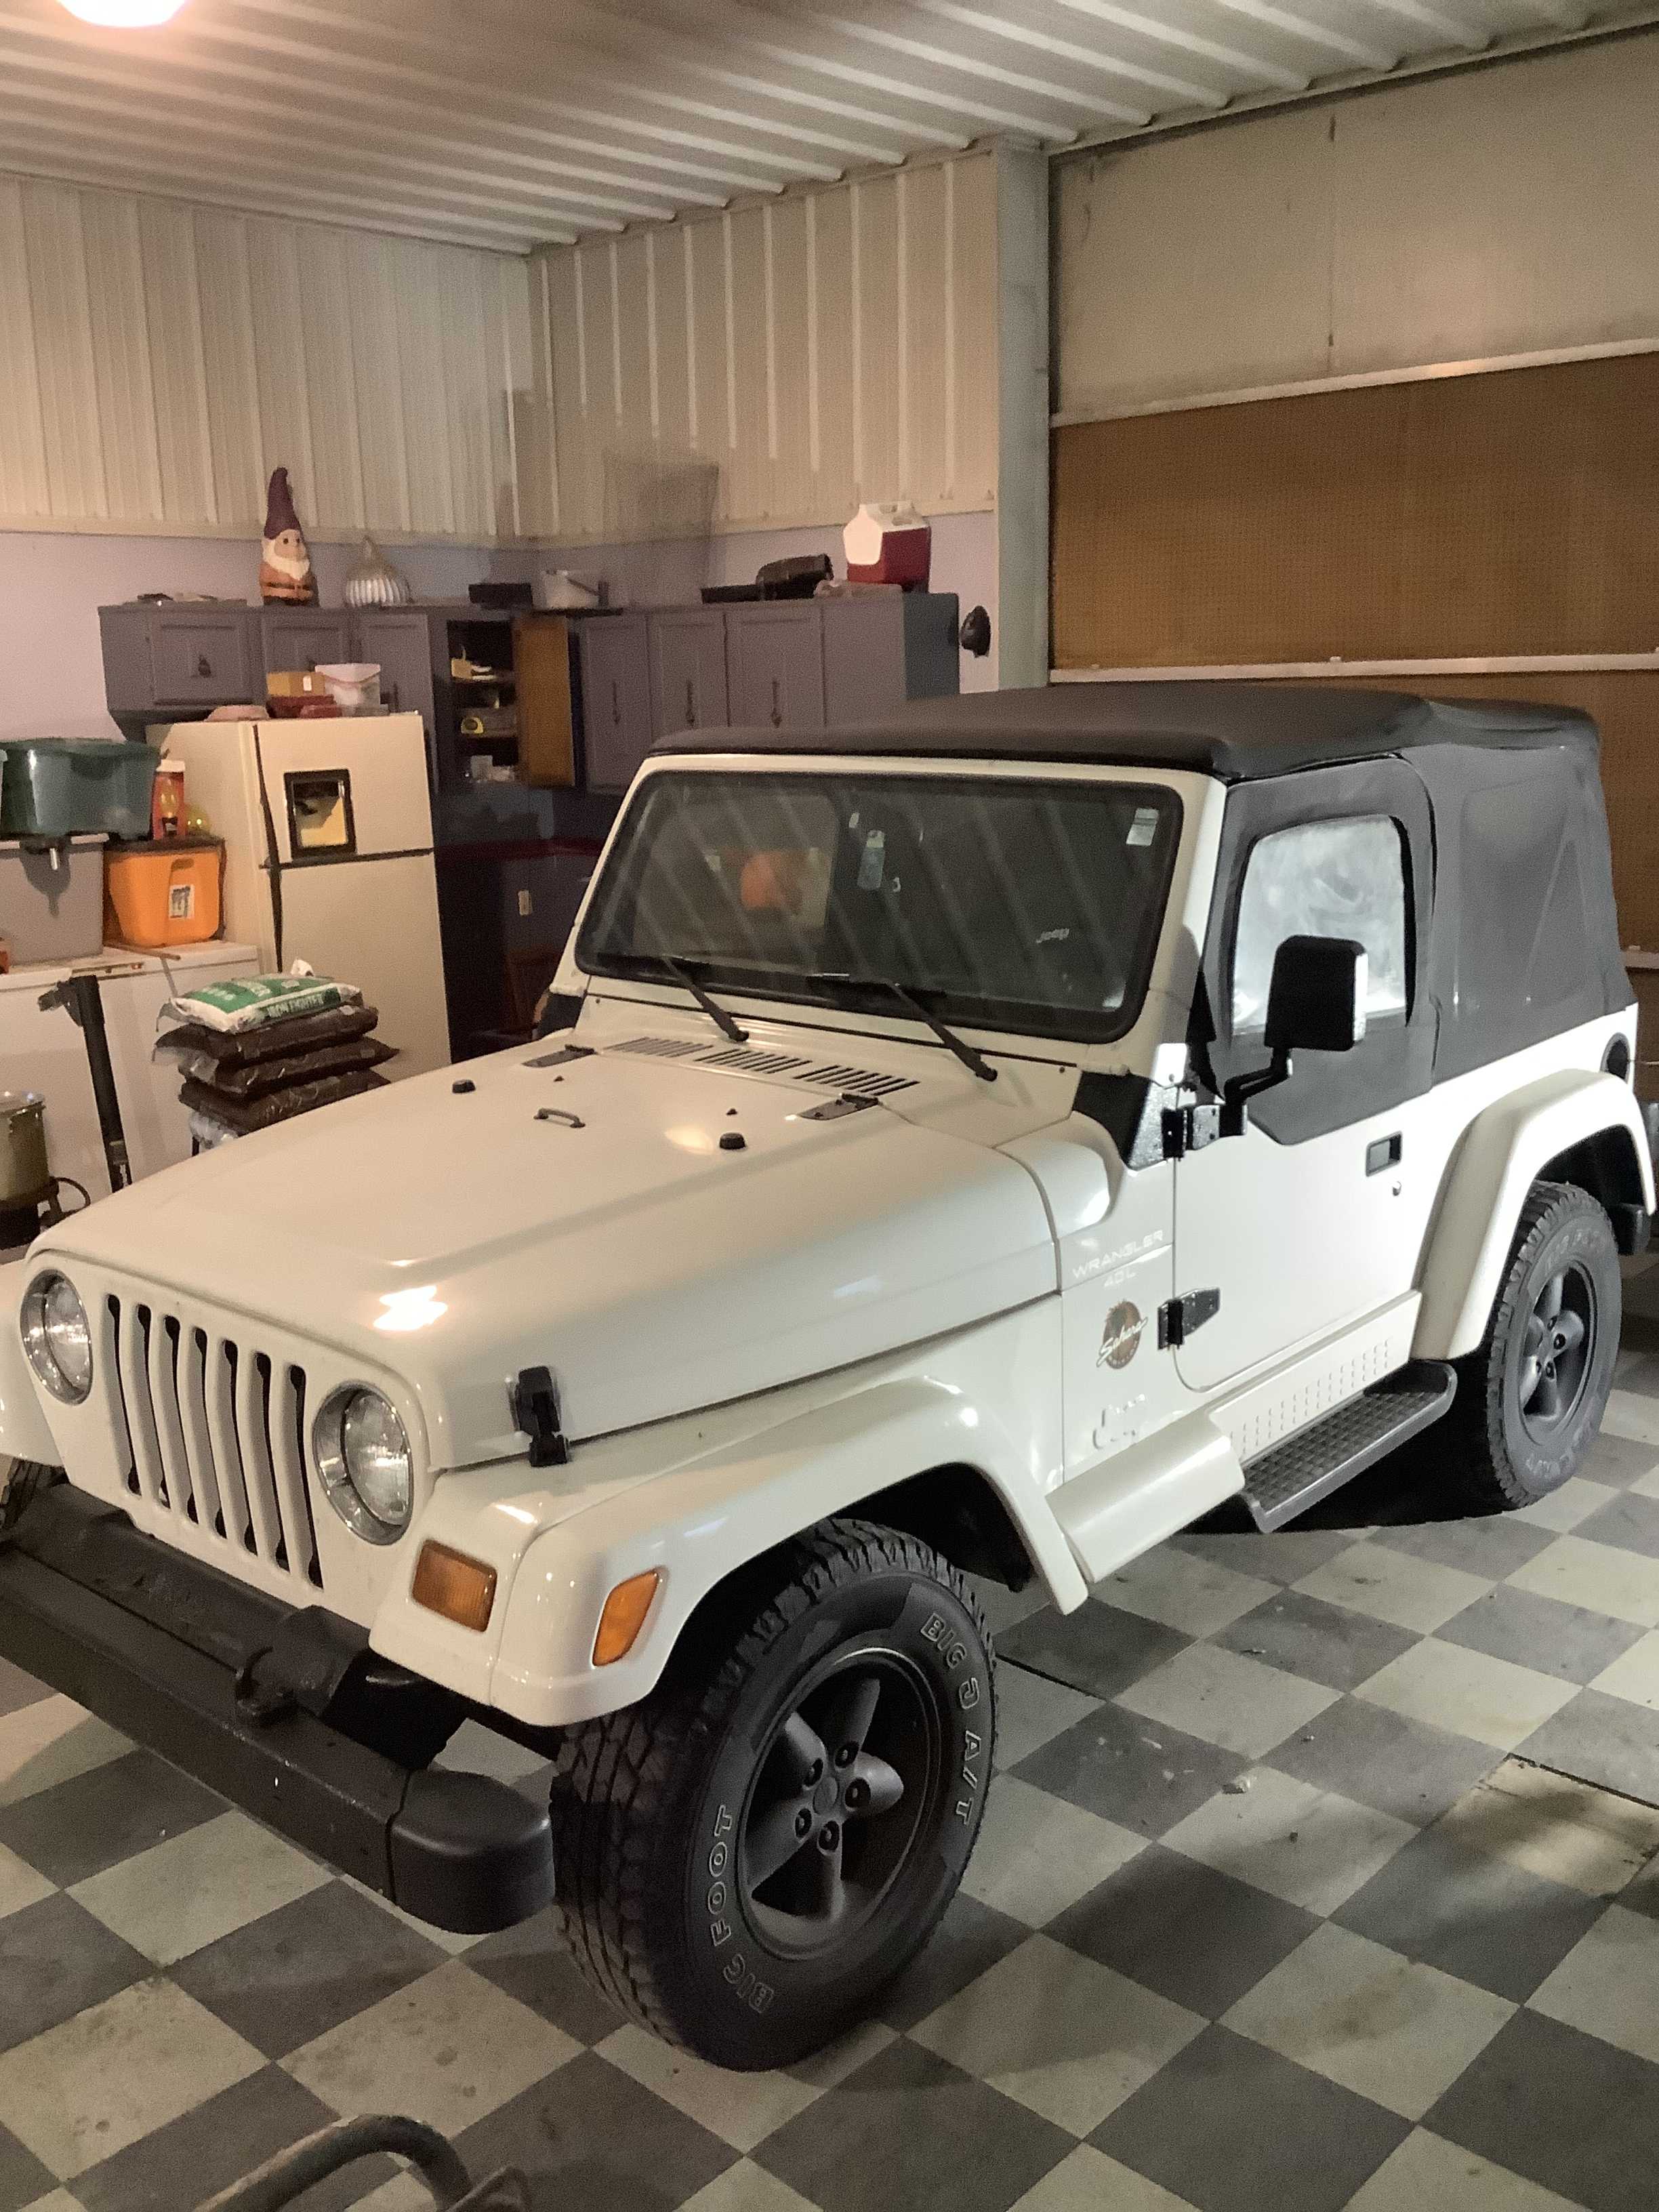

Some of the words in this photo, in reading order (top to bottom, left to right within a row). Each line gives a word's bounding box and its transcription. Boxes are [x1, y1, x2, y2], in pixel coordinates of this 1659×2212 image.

[1072, 1229, 1164, 1279] WRANGLER
[920, 1612, 968, 1669] BIG
[956, 1729, 981, 1826] A/T
[708, 1805, 733, 1947] FOOT
[723, 1954, 775, 2014] BIG
